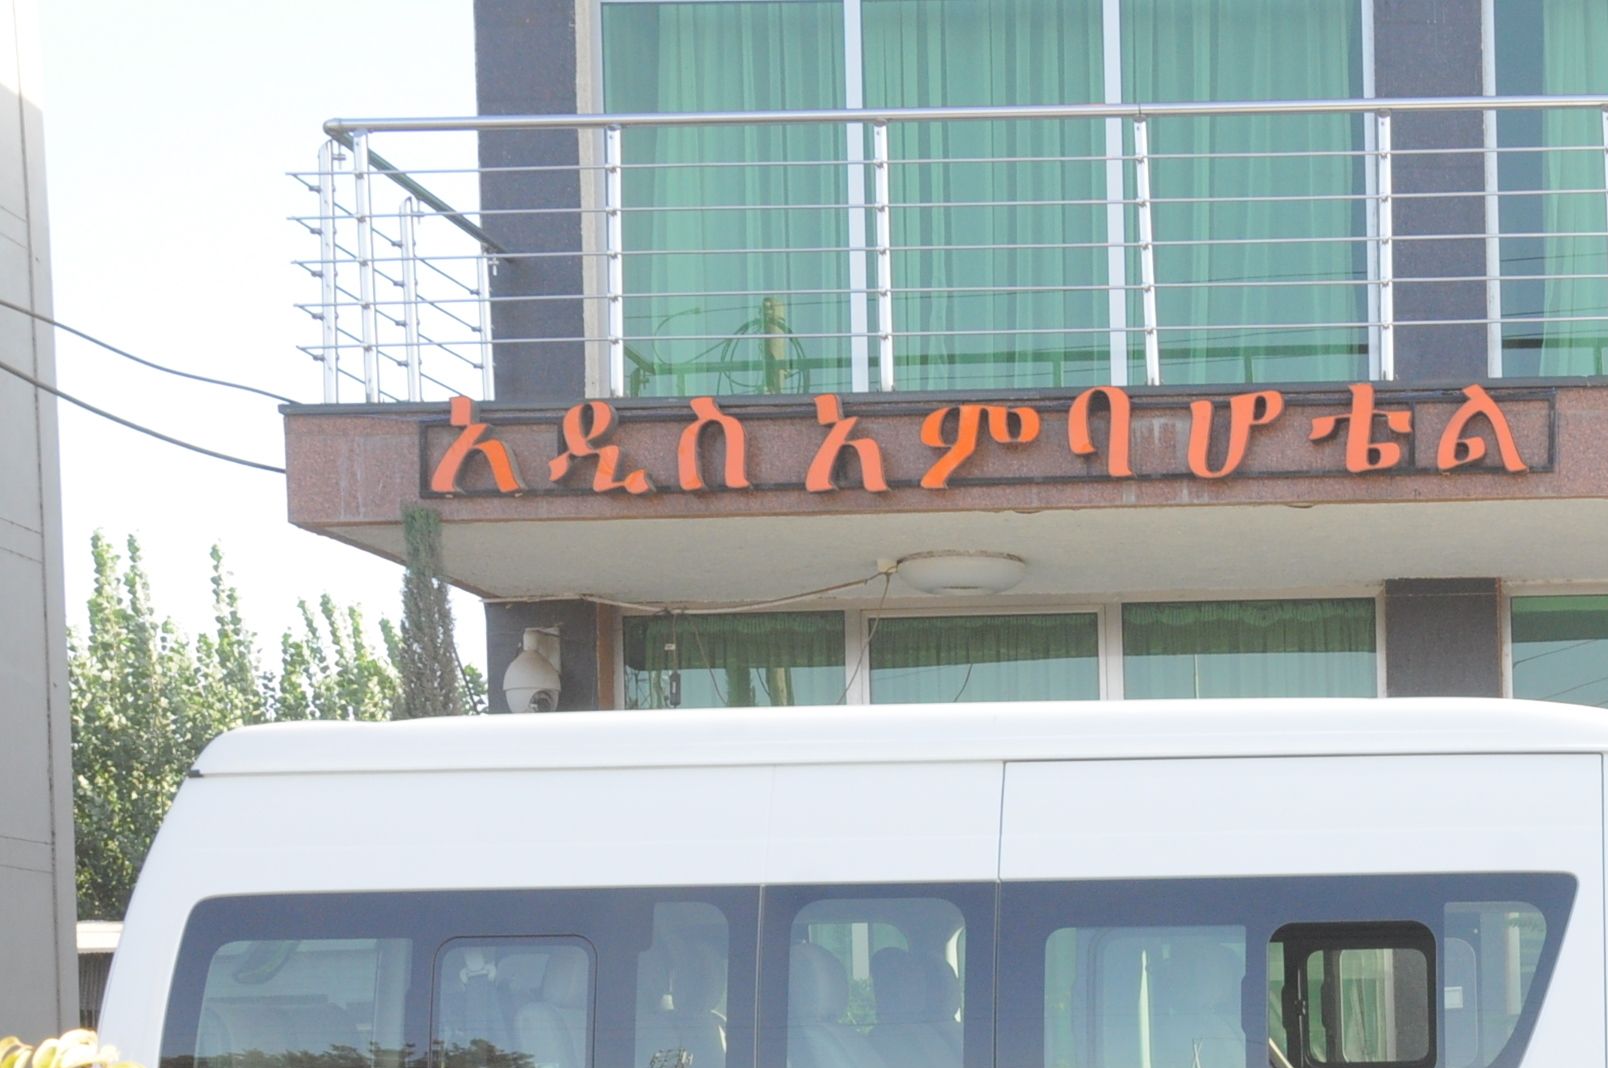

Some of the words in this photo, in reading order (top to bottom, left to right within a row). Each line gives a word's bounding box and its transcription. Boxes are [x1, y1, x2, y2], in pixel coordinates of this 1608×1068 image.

[430, 396, 750, 495] አዲስ
[805, 385, 1132, 493] አምባ
[1186, 383, 1527, 479] ሆቴል
